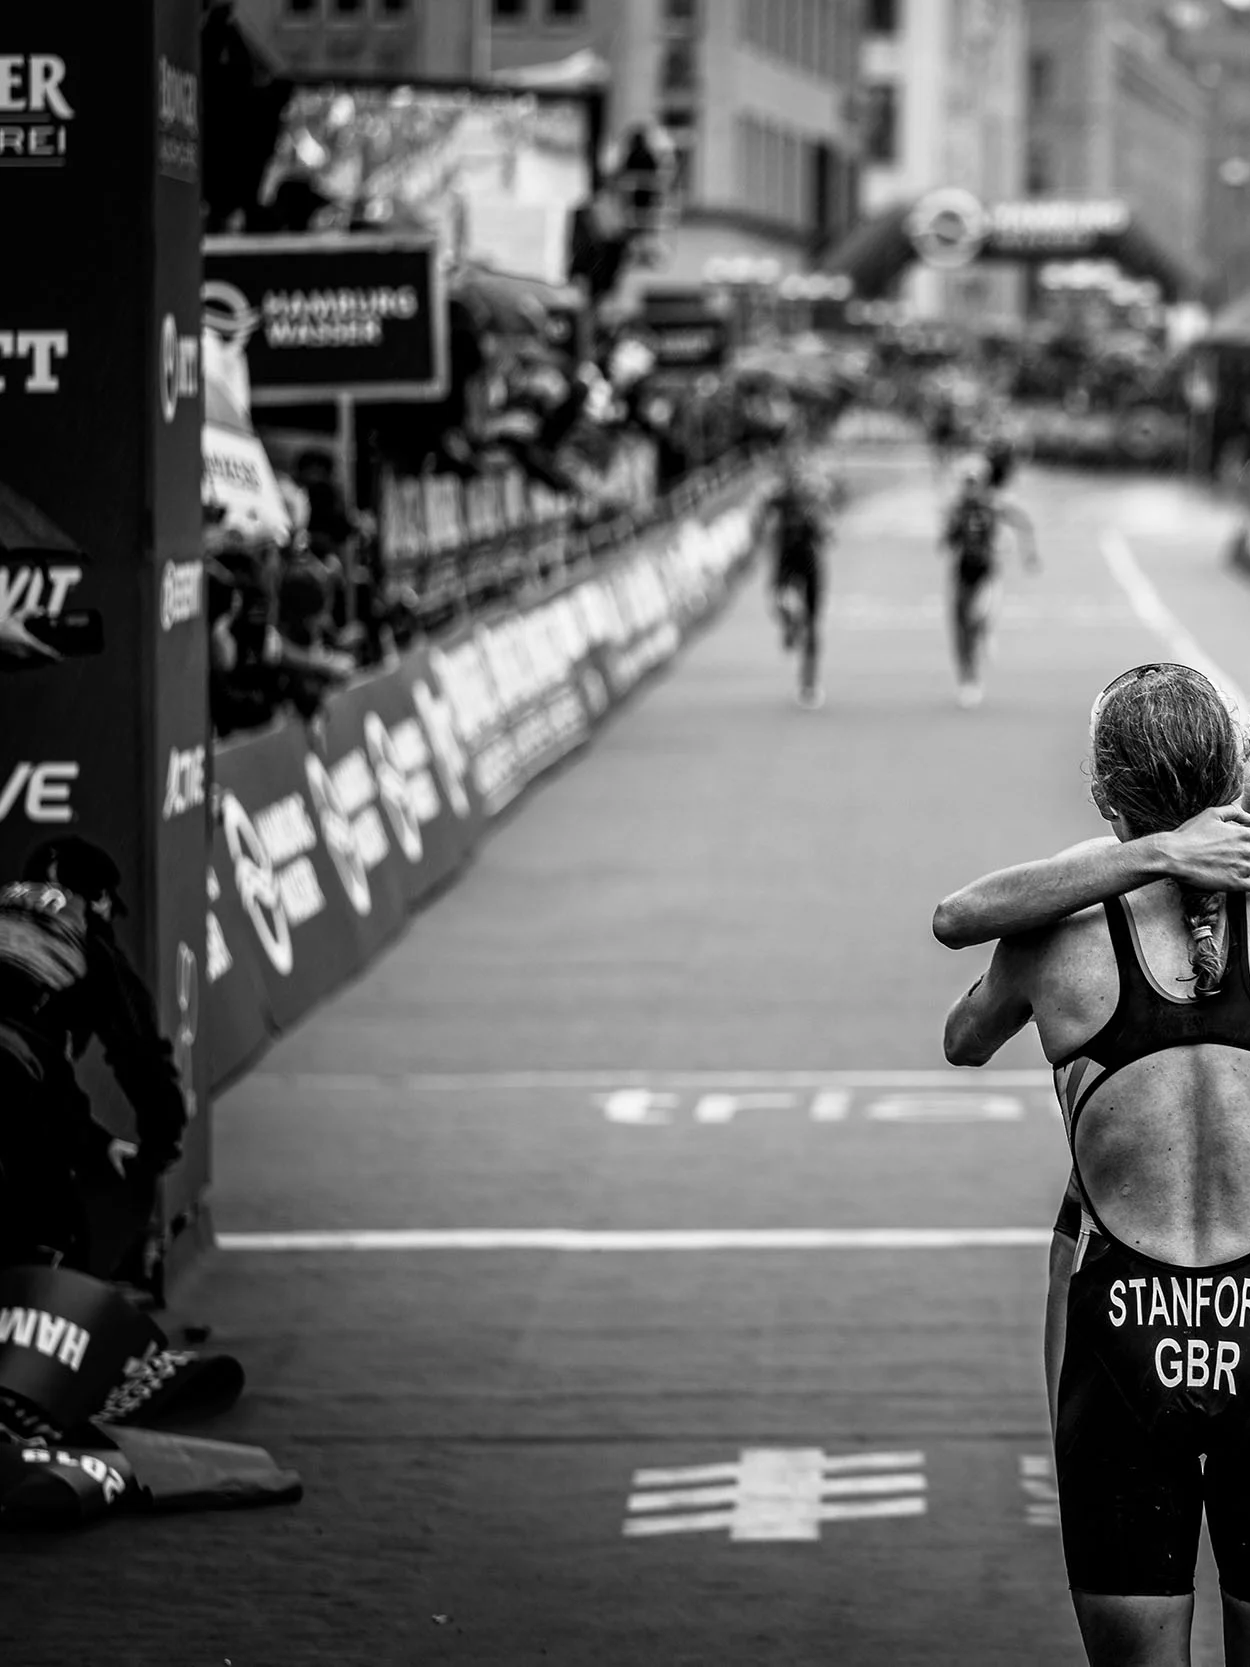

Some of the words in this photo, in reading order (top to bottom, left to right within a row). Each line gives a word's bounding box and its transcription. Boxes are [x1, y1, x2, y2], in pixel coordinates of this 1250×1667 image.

[0, 124, 68, 157] REI
[261, 284, 419, 322] HAMBURG
[264, 317, 384, 350] WASSER
[1154, 1337, 1241, 1396] GBR
